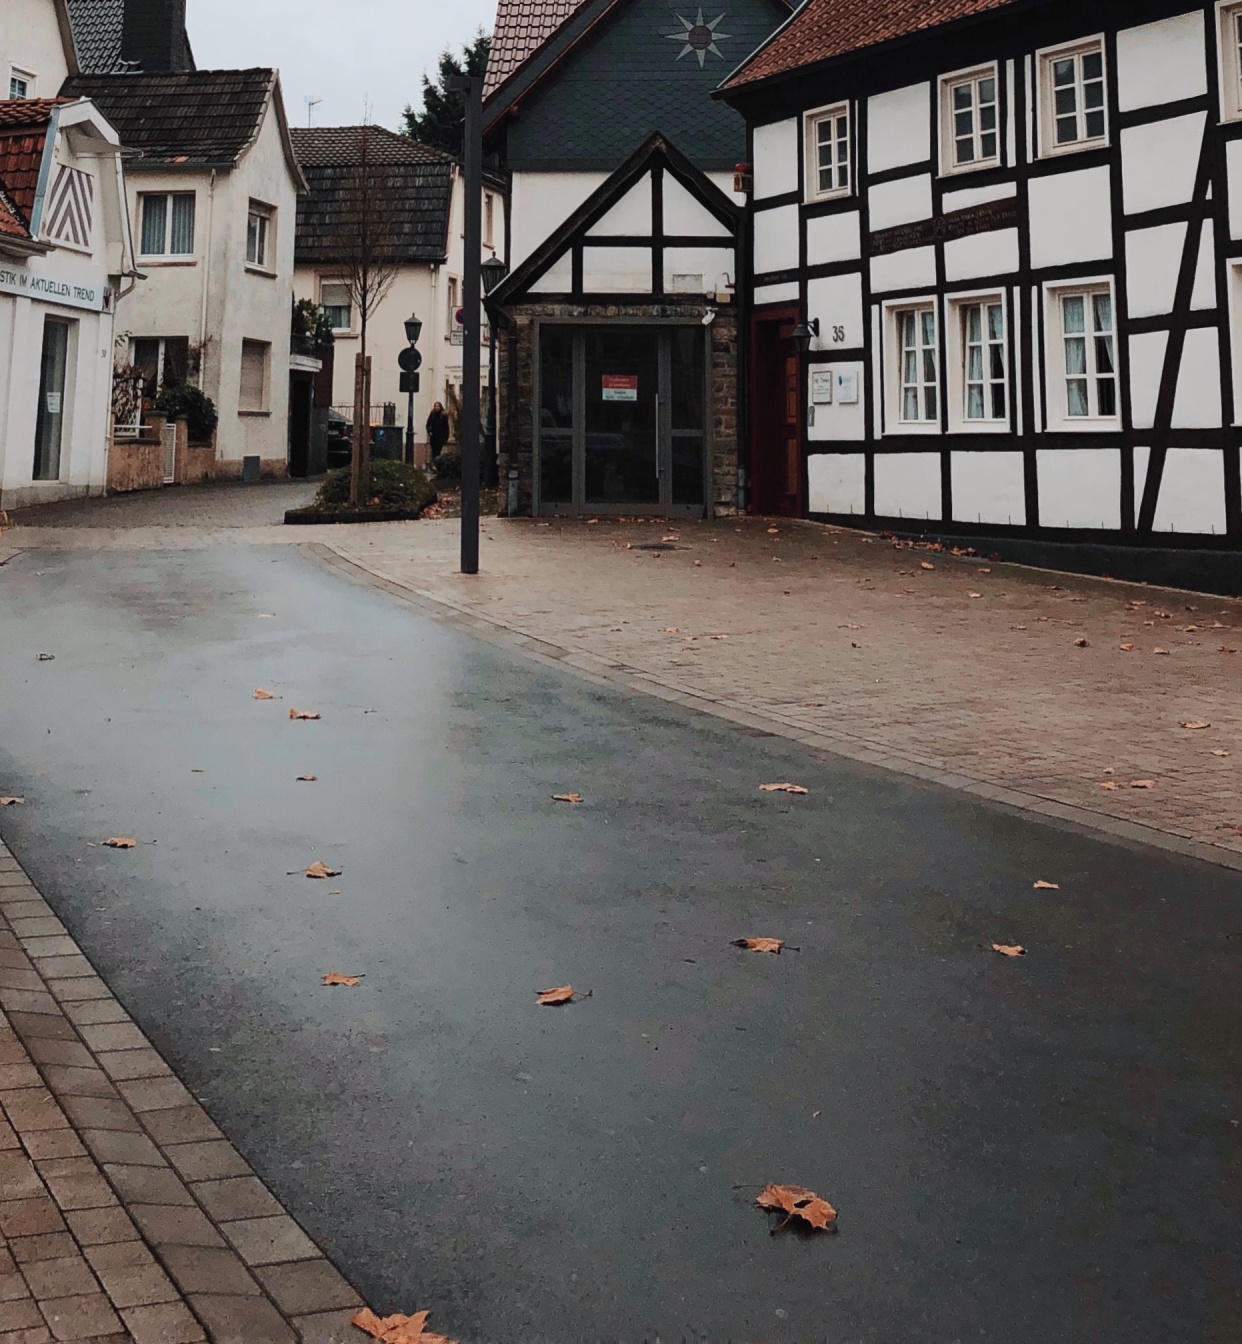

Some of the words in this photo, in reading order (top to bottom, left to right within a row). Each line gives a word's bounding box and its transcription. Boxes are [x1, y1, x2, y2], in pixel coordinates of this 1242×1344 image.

[19, 274, 28, 287] IM
[30, 277, 70, 296] AKTUELLEN
[73, 286, 94, 301] TREND
[832, 325, 845, 342] 35
